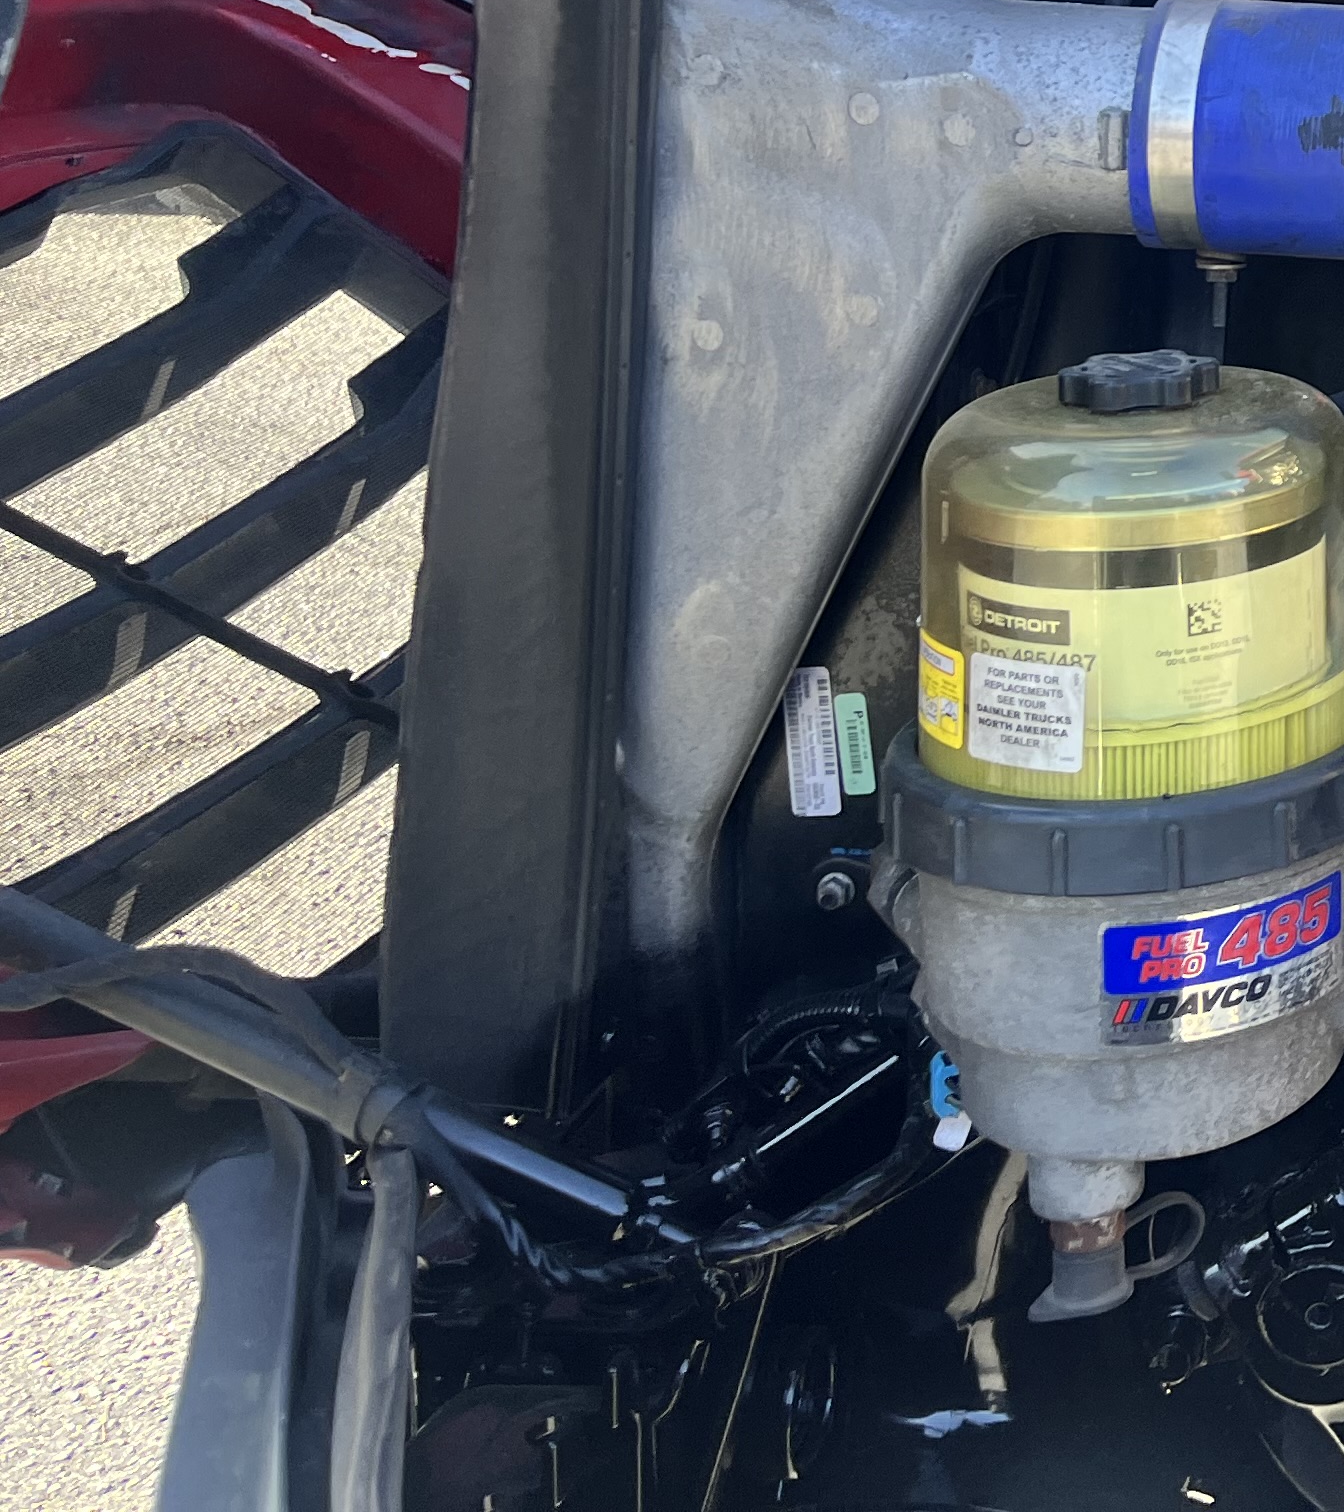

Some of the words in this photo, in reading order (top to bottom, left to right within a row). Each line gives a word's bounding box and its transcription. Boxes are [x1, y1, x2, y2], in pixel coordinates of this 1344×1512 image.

[984, 610, 1061, 635] DETROIT
[987, 666, 1007, 679] FOR
[1008, 667, 1041, 684] PARTS
[1043, 673, 1060, 685] OR
[984, 679, 1064, 699] REPLACEMENTS
[997, 694, 1015, 706] SEE
[1018, 697, 1047, 710] YOUR
[976, 703, 1021, 720] DAIMLER
[1024, 711, 1072, 725] TRUCKS
[978, 717, 1014, 732] NORTH
[1015, 724, 1069, 738] AMERICA
[1000, 734, 1040, 748] DEALER
[1131, 928, 1209, 960] FUEL
[1217, 882, 1332, 969] 485
[1139, 952, 1207, 984] PRO
[1145, 973, 1272, 1022] DAVCO
